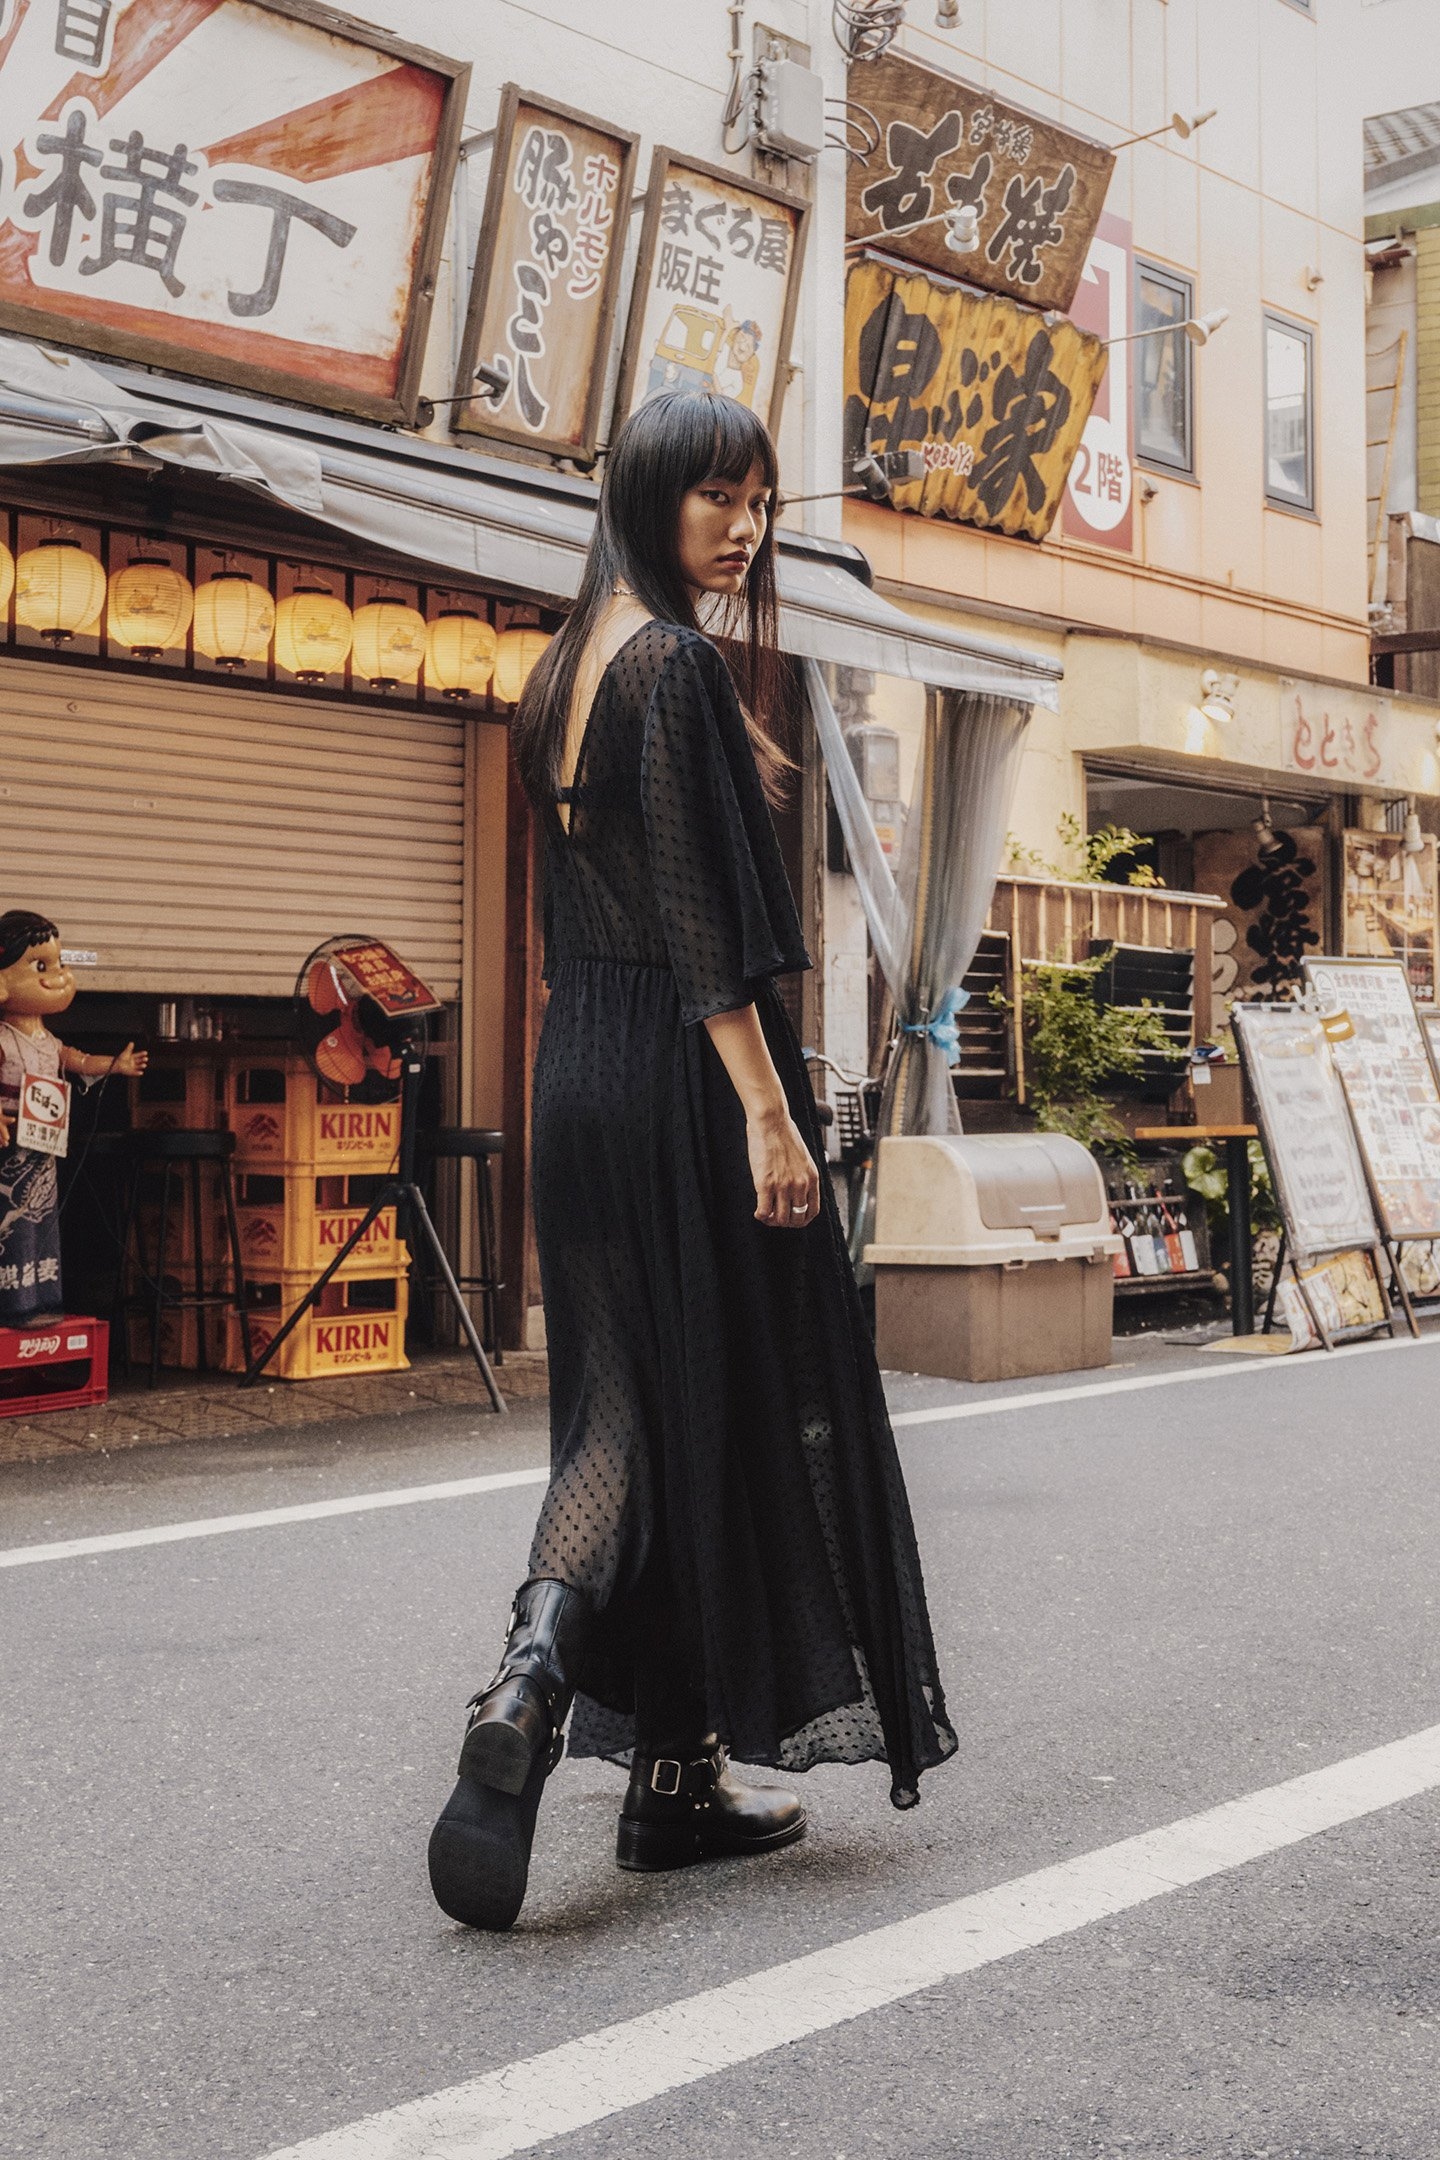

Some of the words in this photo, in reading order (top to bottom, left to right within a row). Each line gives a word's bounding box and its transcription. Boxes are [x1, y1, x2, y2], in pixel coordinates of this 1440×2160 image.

[567, 155, 619, 297] ホルモン
[661, 182, 791, 276] まぐろ屋
[656, 241, 724, 305] 阪庄
[922, 441, 974, 476] KOBUYA
[1074, 443, 1123, 504] 2階
[30, 1085, 60, 1118] たばこ
[320, 1112, 391, 1139] KIRIN
[317, 1322, 389, 1353] KIRIN
